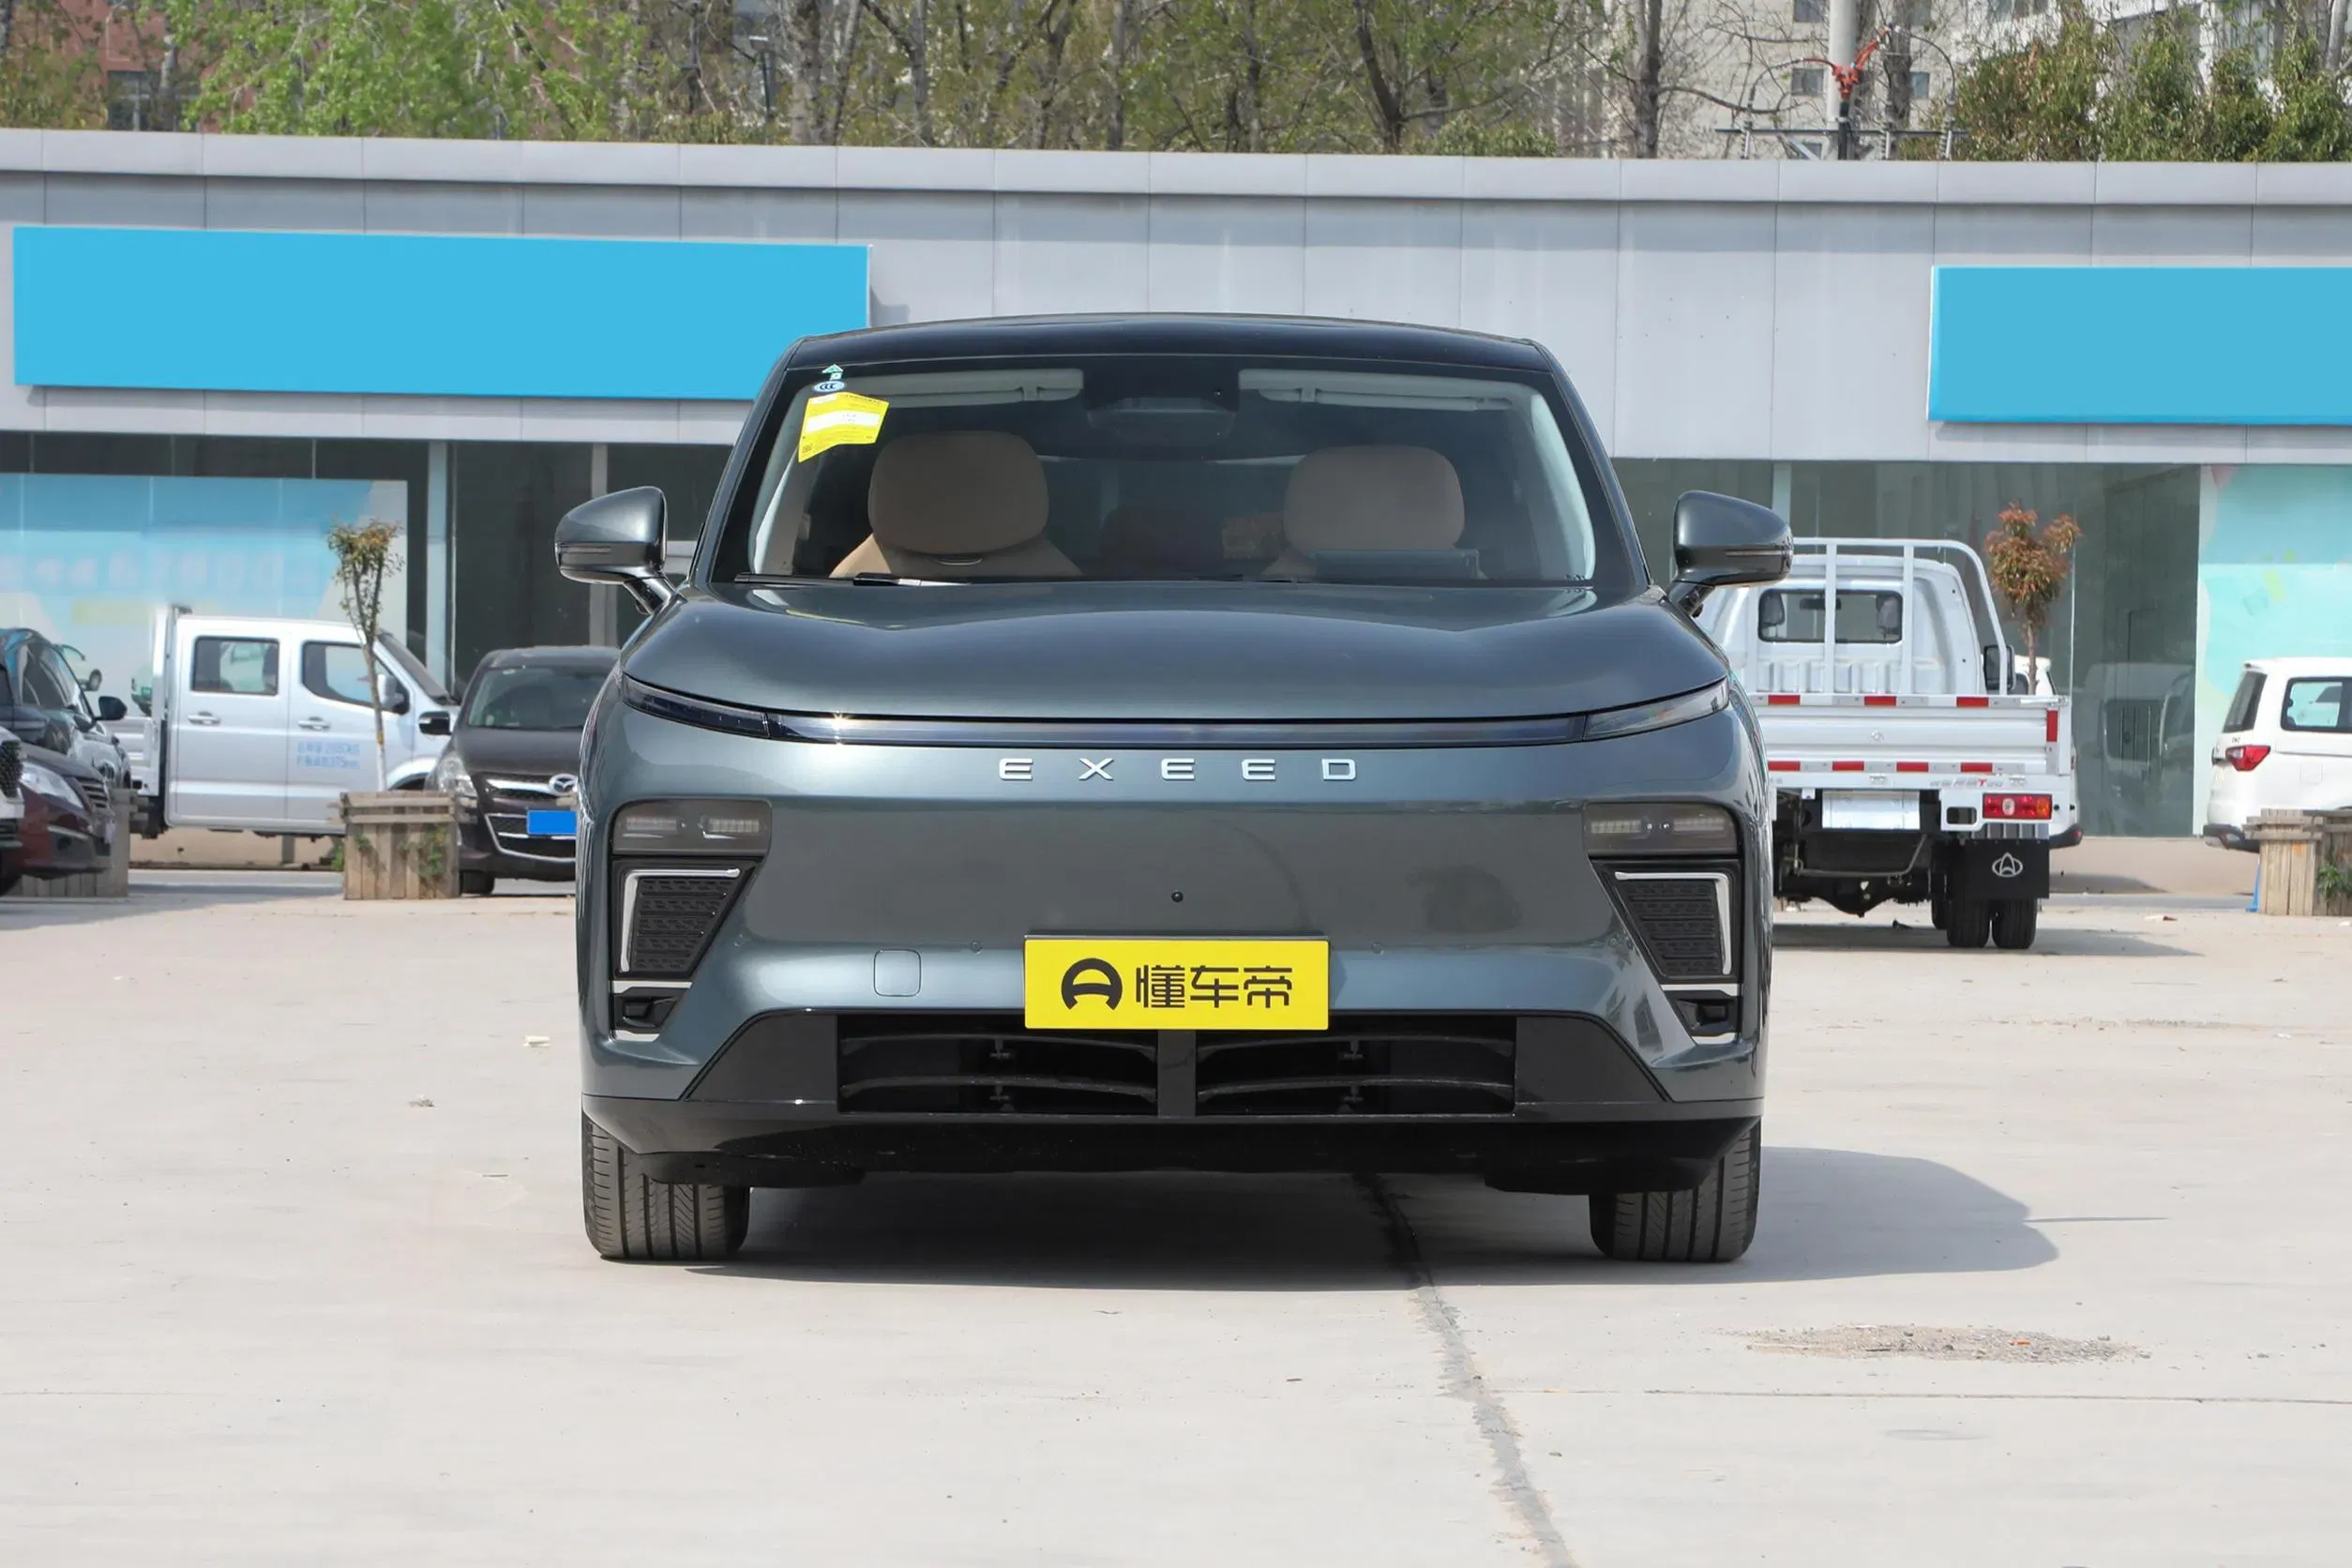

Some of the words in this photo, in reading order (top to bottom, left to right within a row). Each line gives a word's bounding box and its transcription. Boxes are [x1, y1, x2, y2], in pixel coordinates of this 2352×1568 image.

[999, 758, 1357, 780] EXEED
[1136, 964, 1293, 1009] 懂车帝
